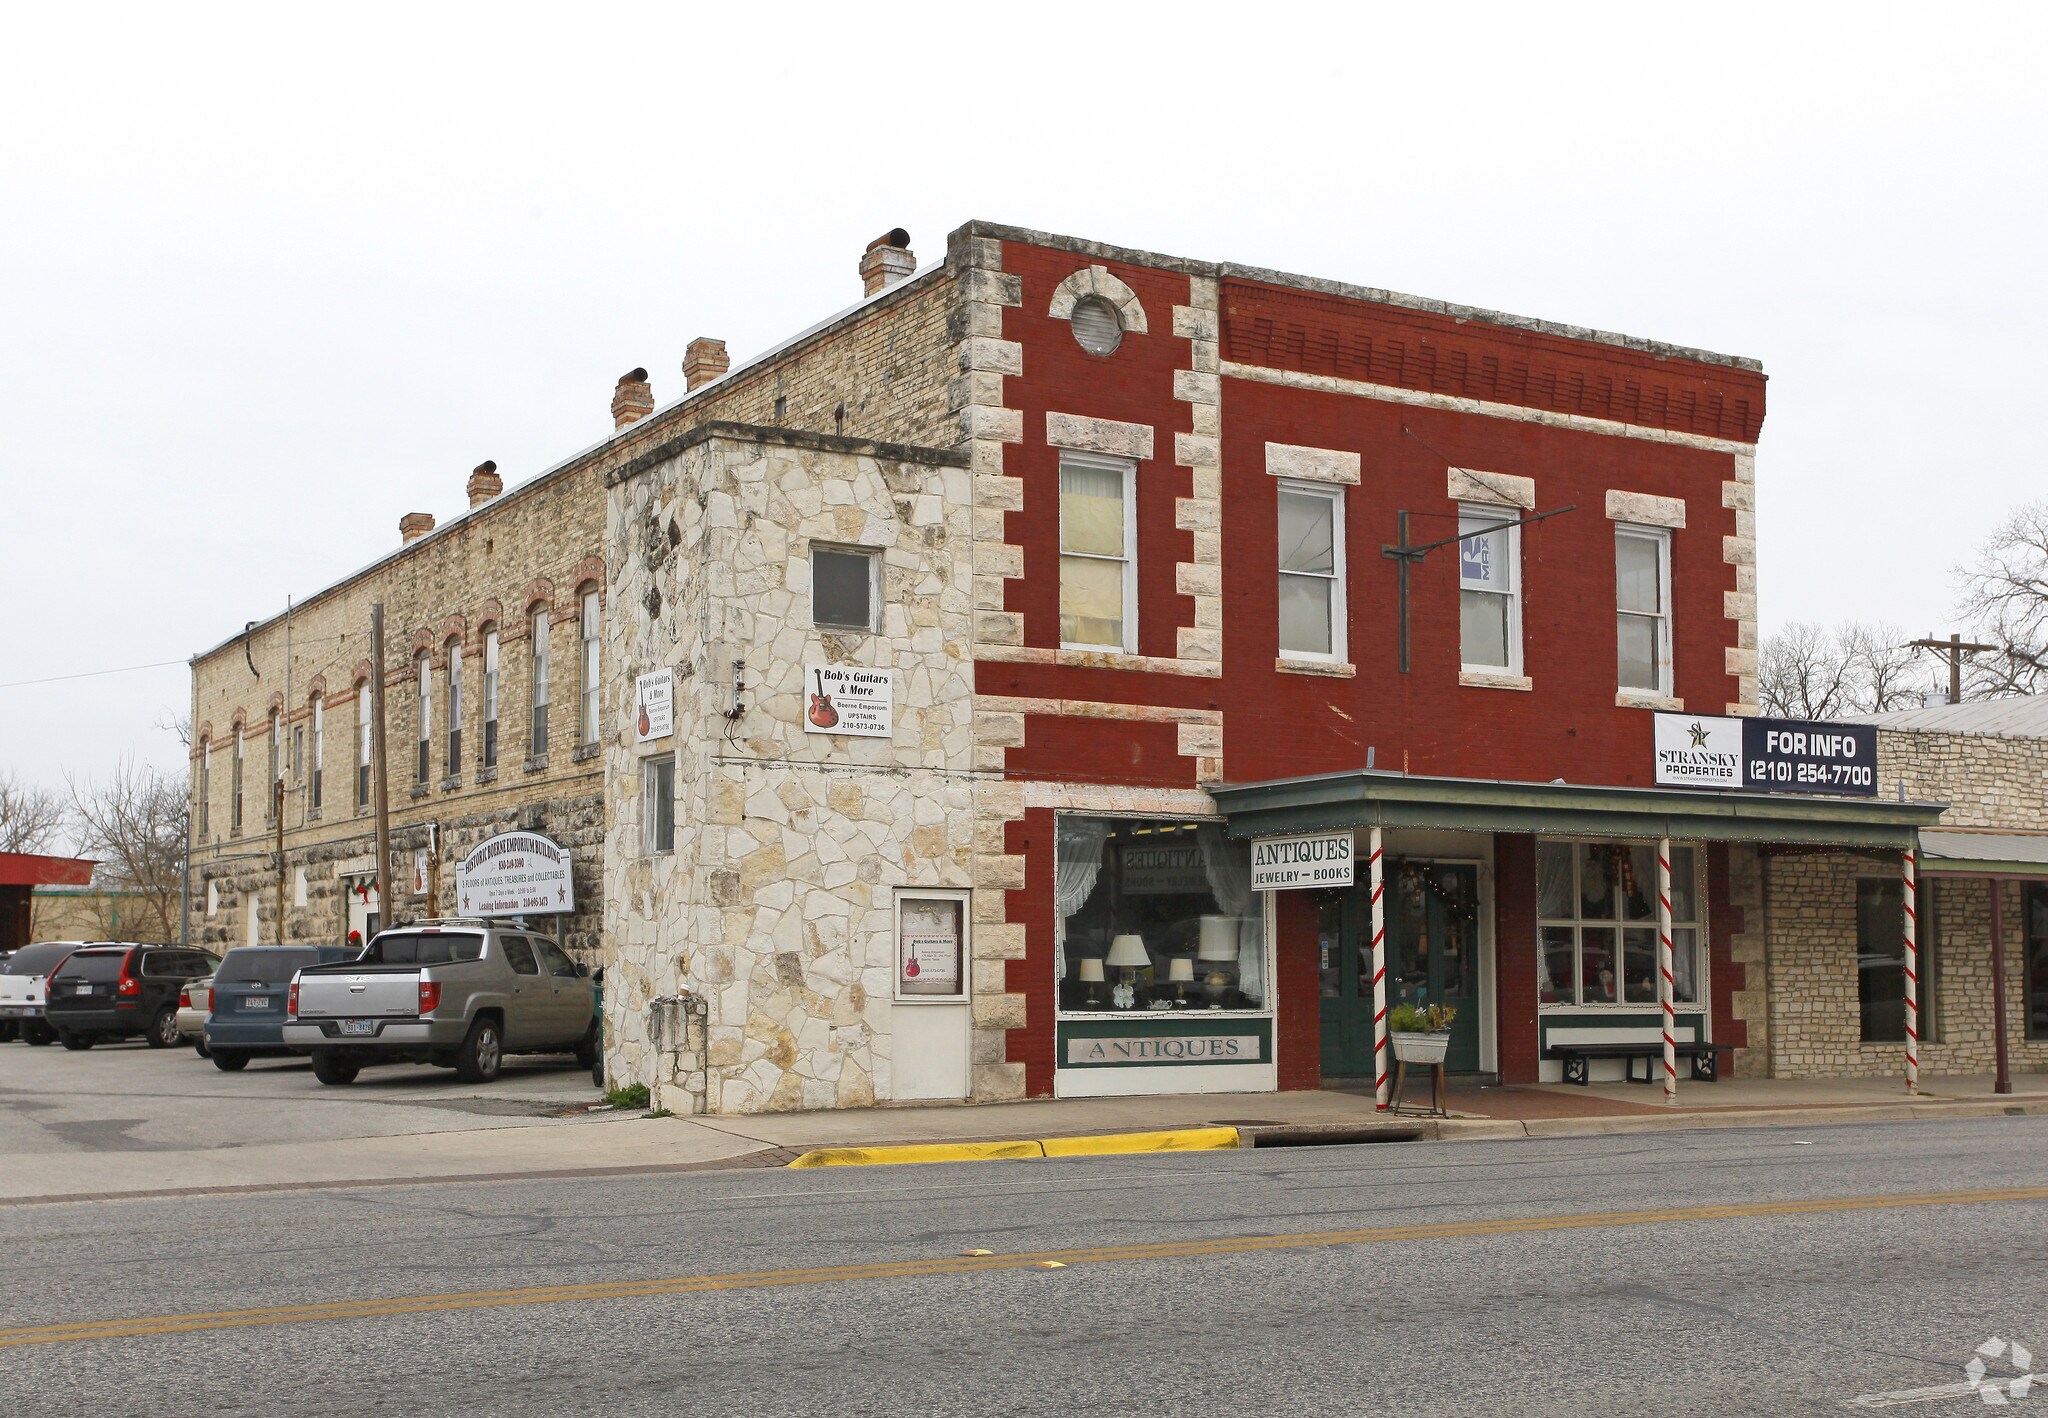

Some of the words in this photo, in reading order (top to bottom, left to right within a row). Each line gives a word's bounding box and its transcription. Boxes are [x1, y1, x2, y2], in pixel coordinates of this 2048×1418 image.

[1481, 538, 1489, 580] MAX
[643, 678, 654, 689] Bob's
[655, 675, 670, 686] Guitars
[824, 669, 850, 681] Bob's
[853, 672, 889, 684] Guitars
[654, 688, 664, 698] More
[839, 683, 846, 694] &
[849, 684, 874, 696] More
[837, 701, 857, 709] Boerne
[858, 703, 887, 711] Emporium
[842, 722, 885, 731] 210-573-0736
[1767, 730, 1806, 755] FOR
[1811, 734, 1856, 758] INFO
[1659, 749, 1739, 767] STRANSKY
[1666, 764, 1733, 777] PROPERTIES
[1750, 760, 1791, 781] (210)
[1797, 763, 1871, 786] 254-7700
[465, 849, 487, 874] HISTORIC
[488, 839, 506, 859] BOERNE
[507, 837, 534, 854] EMPORIUM
[535, 839, 560, 864] BUILDING
[1255, 838, 1350, 866] ANTIQUES
[504, 874, 526, 884] TREASURES
[535, 870, 565, 882] COLLECTABLES
[1255, 870, 1299, 884] JEWELRY
[1314, 867, 1350, 880] BOOKS
[478, 901, 494, 913] Leasing
[494, 898, 519, 910] Information
[1089, 1039, 1239, 1058] ANTIQUES
